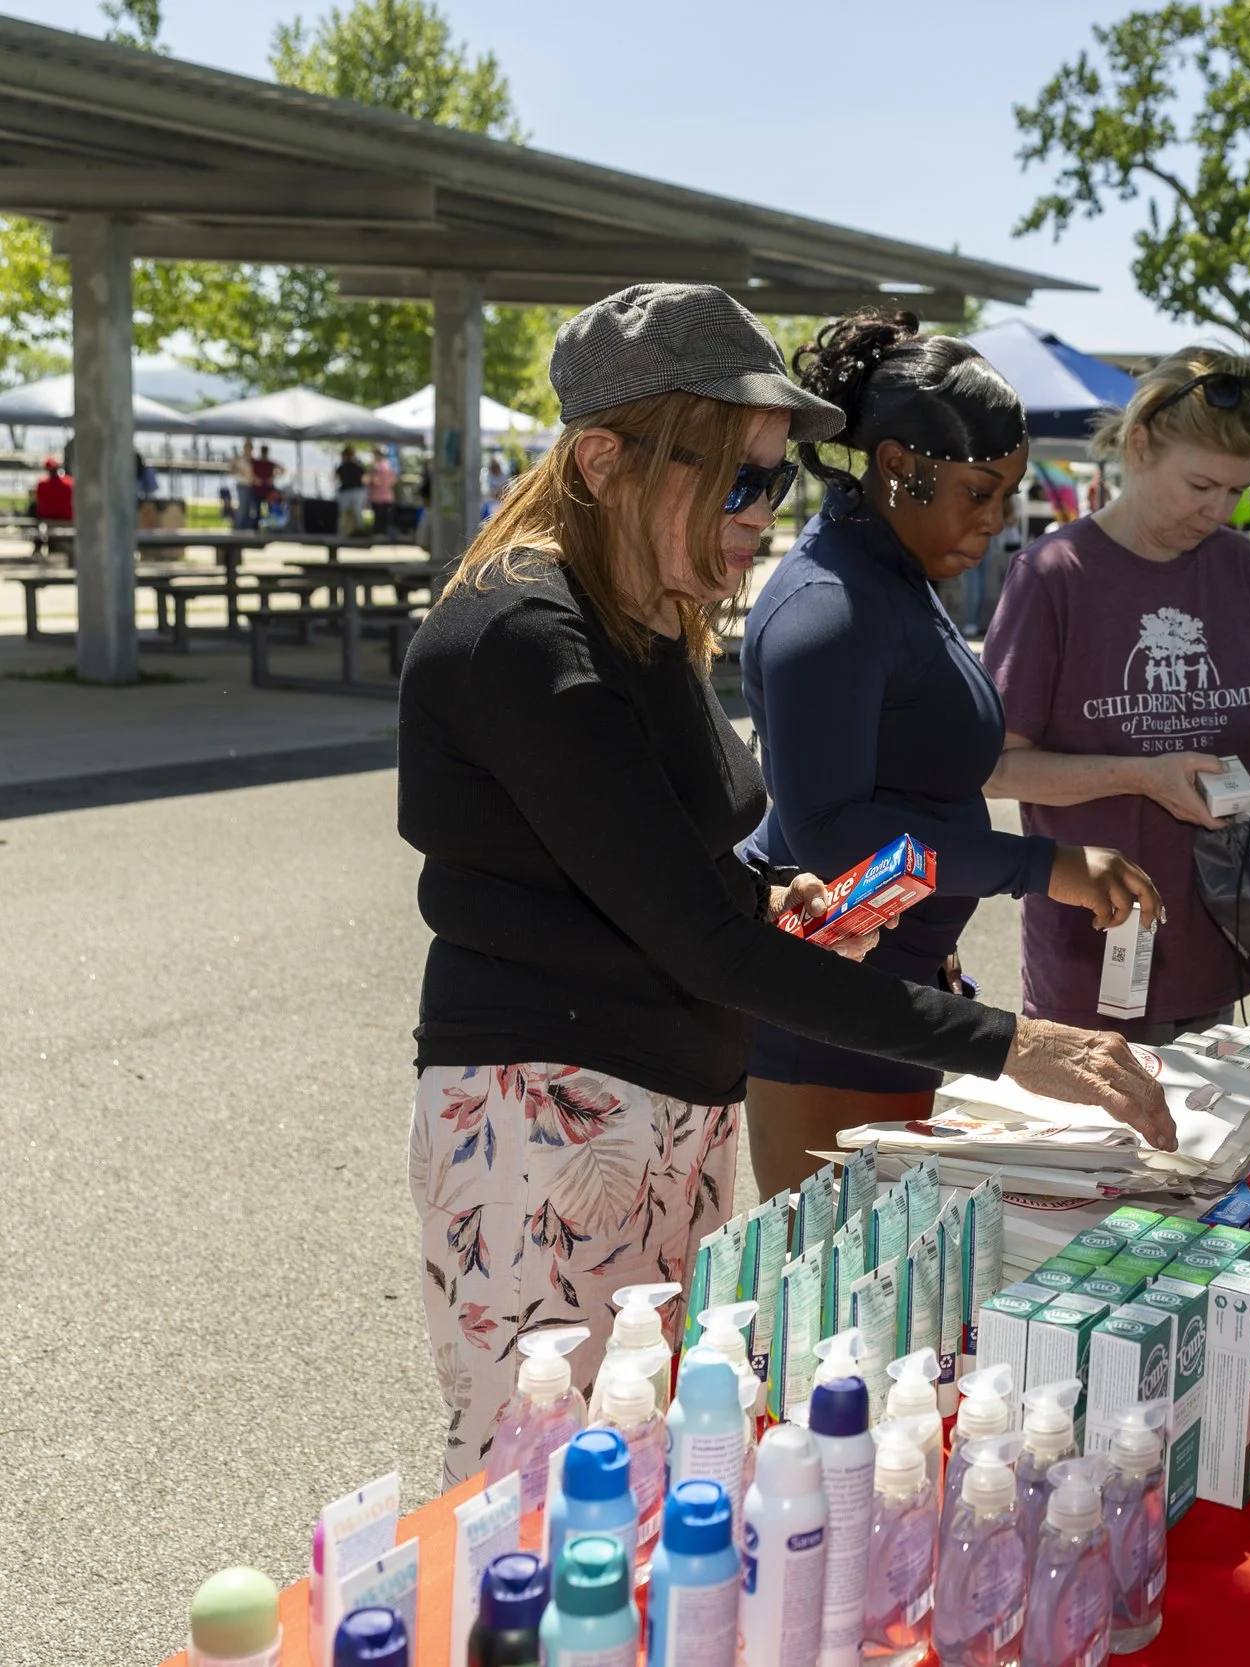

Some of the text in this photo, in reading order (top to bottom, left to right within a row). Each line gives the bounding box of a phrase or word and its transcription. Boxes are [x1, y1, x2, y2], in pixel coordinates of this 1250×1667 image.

[1083, 691, 1206, 720] CHILDREN'S
[1121, 715, 1139, 735] of
[1142, 739, 1184, 751] SINCE
[865, 856, 892, 879] Cavity
[1177, 1322, 1207, 1373] Tom's
[1139, 1350, 1170, 1401] Tom's
